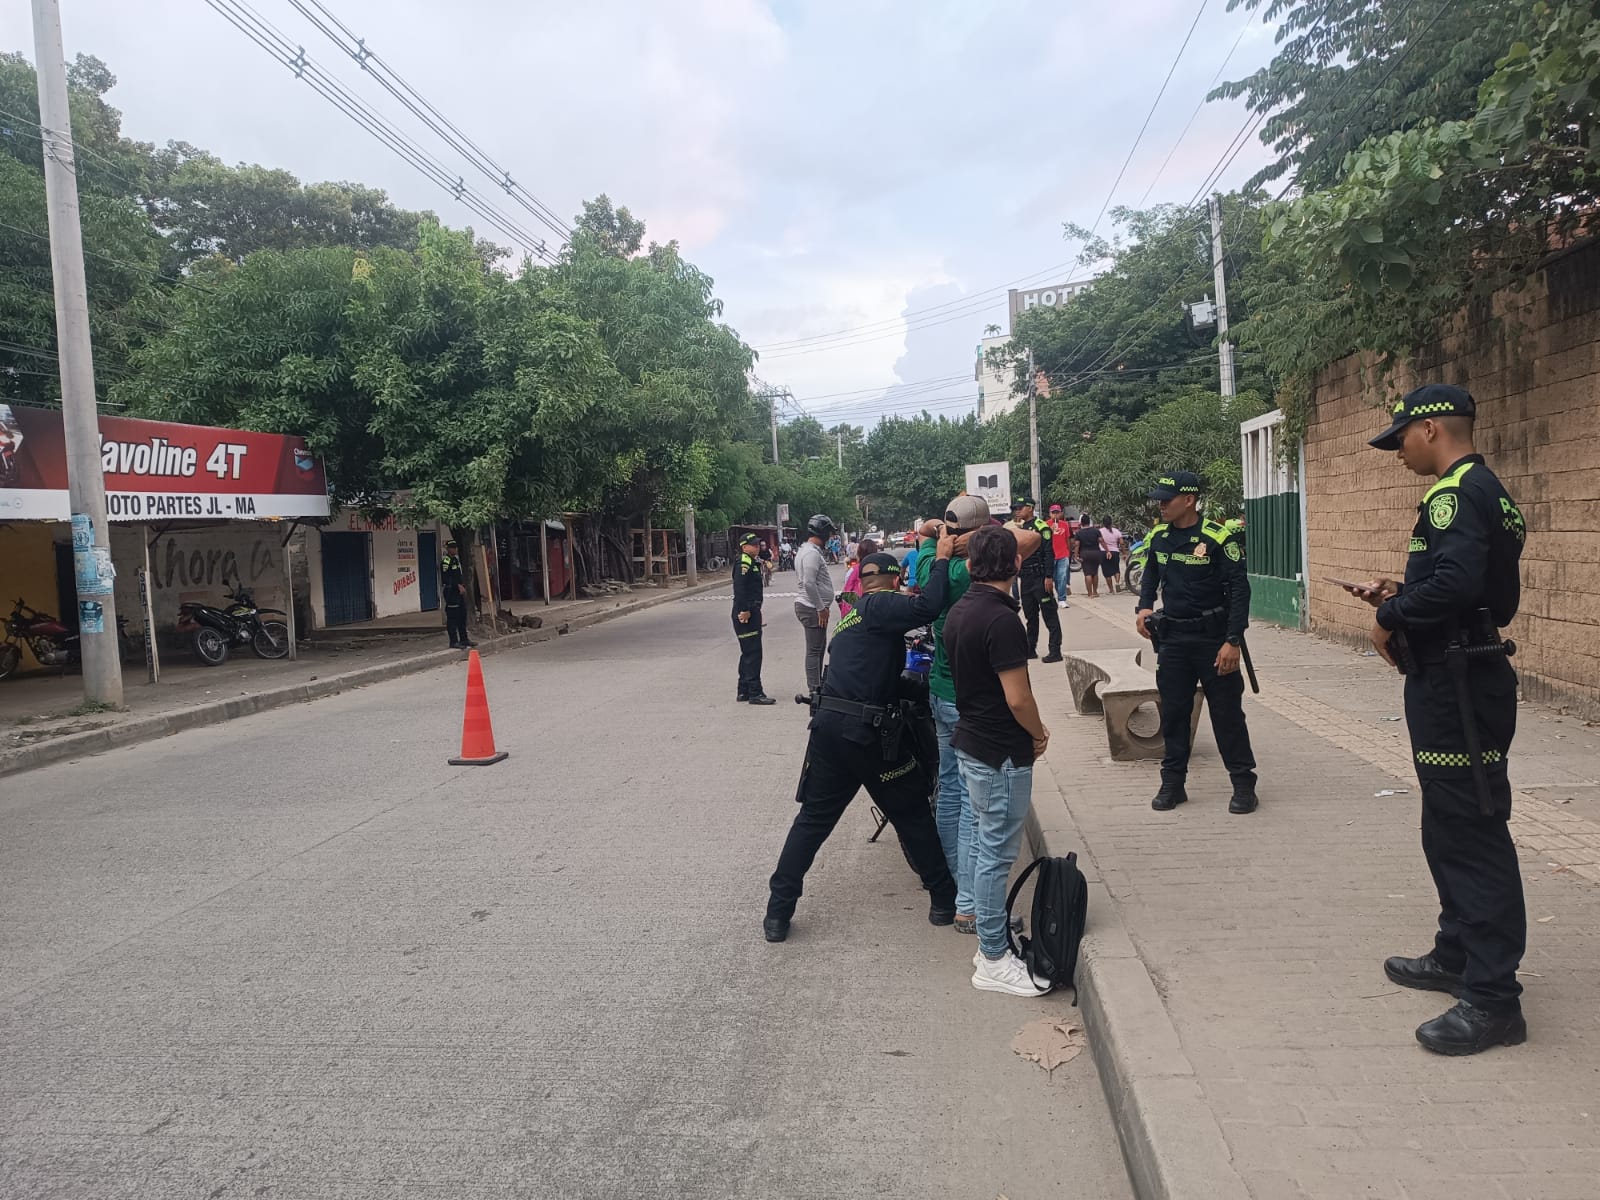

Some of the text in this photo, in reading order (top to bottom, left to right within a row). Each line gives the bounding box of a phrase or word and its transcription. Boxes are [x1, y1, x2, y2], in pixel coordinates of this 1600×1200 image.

[99, 432, 247, 479] avoline 4T
[146, 496, 202, 515] PARTES
[206, 497, 222, 515] JL
[235, 497, 256, 515] MA
